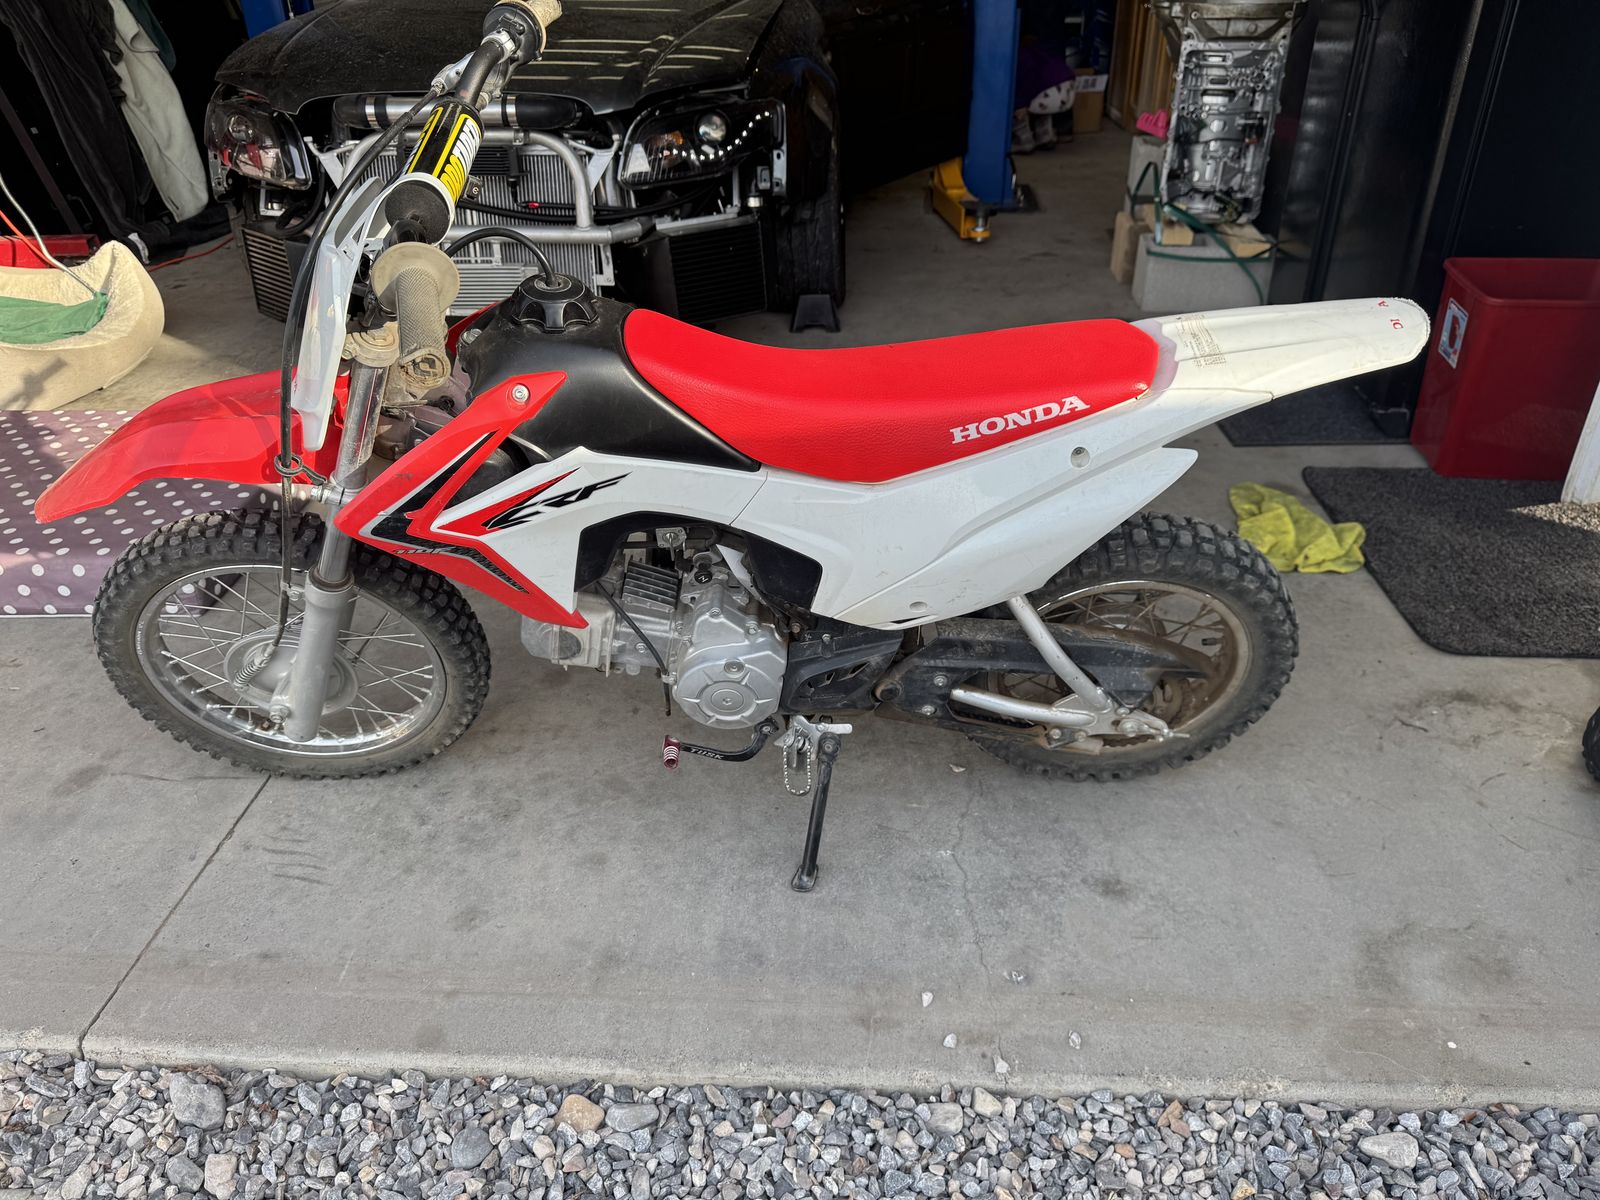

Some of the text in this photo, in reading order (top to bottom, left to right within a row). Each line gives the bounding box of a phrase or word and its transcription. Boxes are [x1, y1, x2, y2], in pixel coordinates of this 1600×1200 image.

[950, 395, 1090, 444] HONDA
[483, 471, 633, 530] CRF
[690, 748, 725, 760] TUSK
